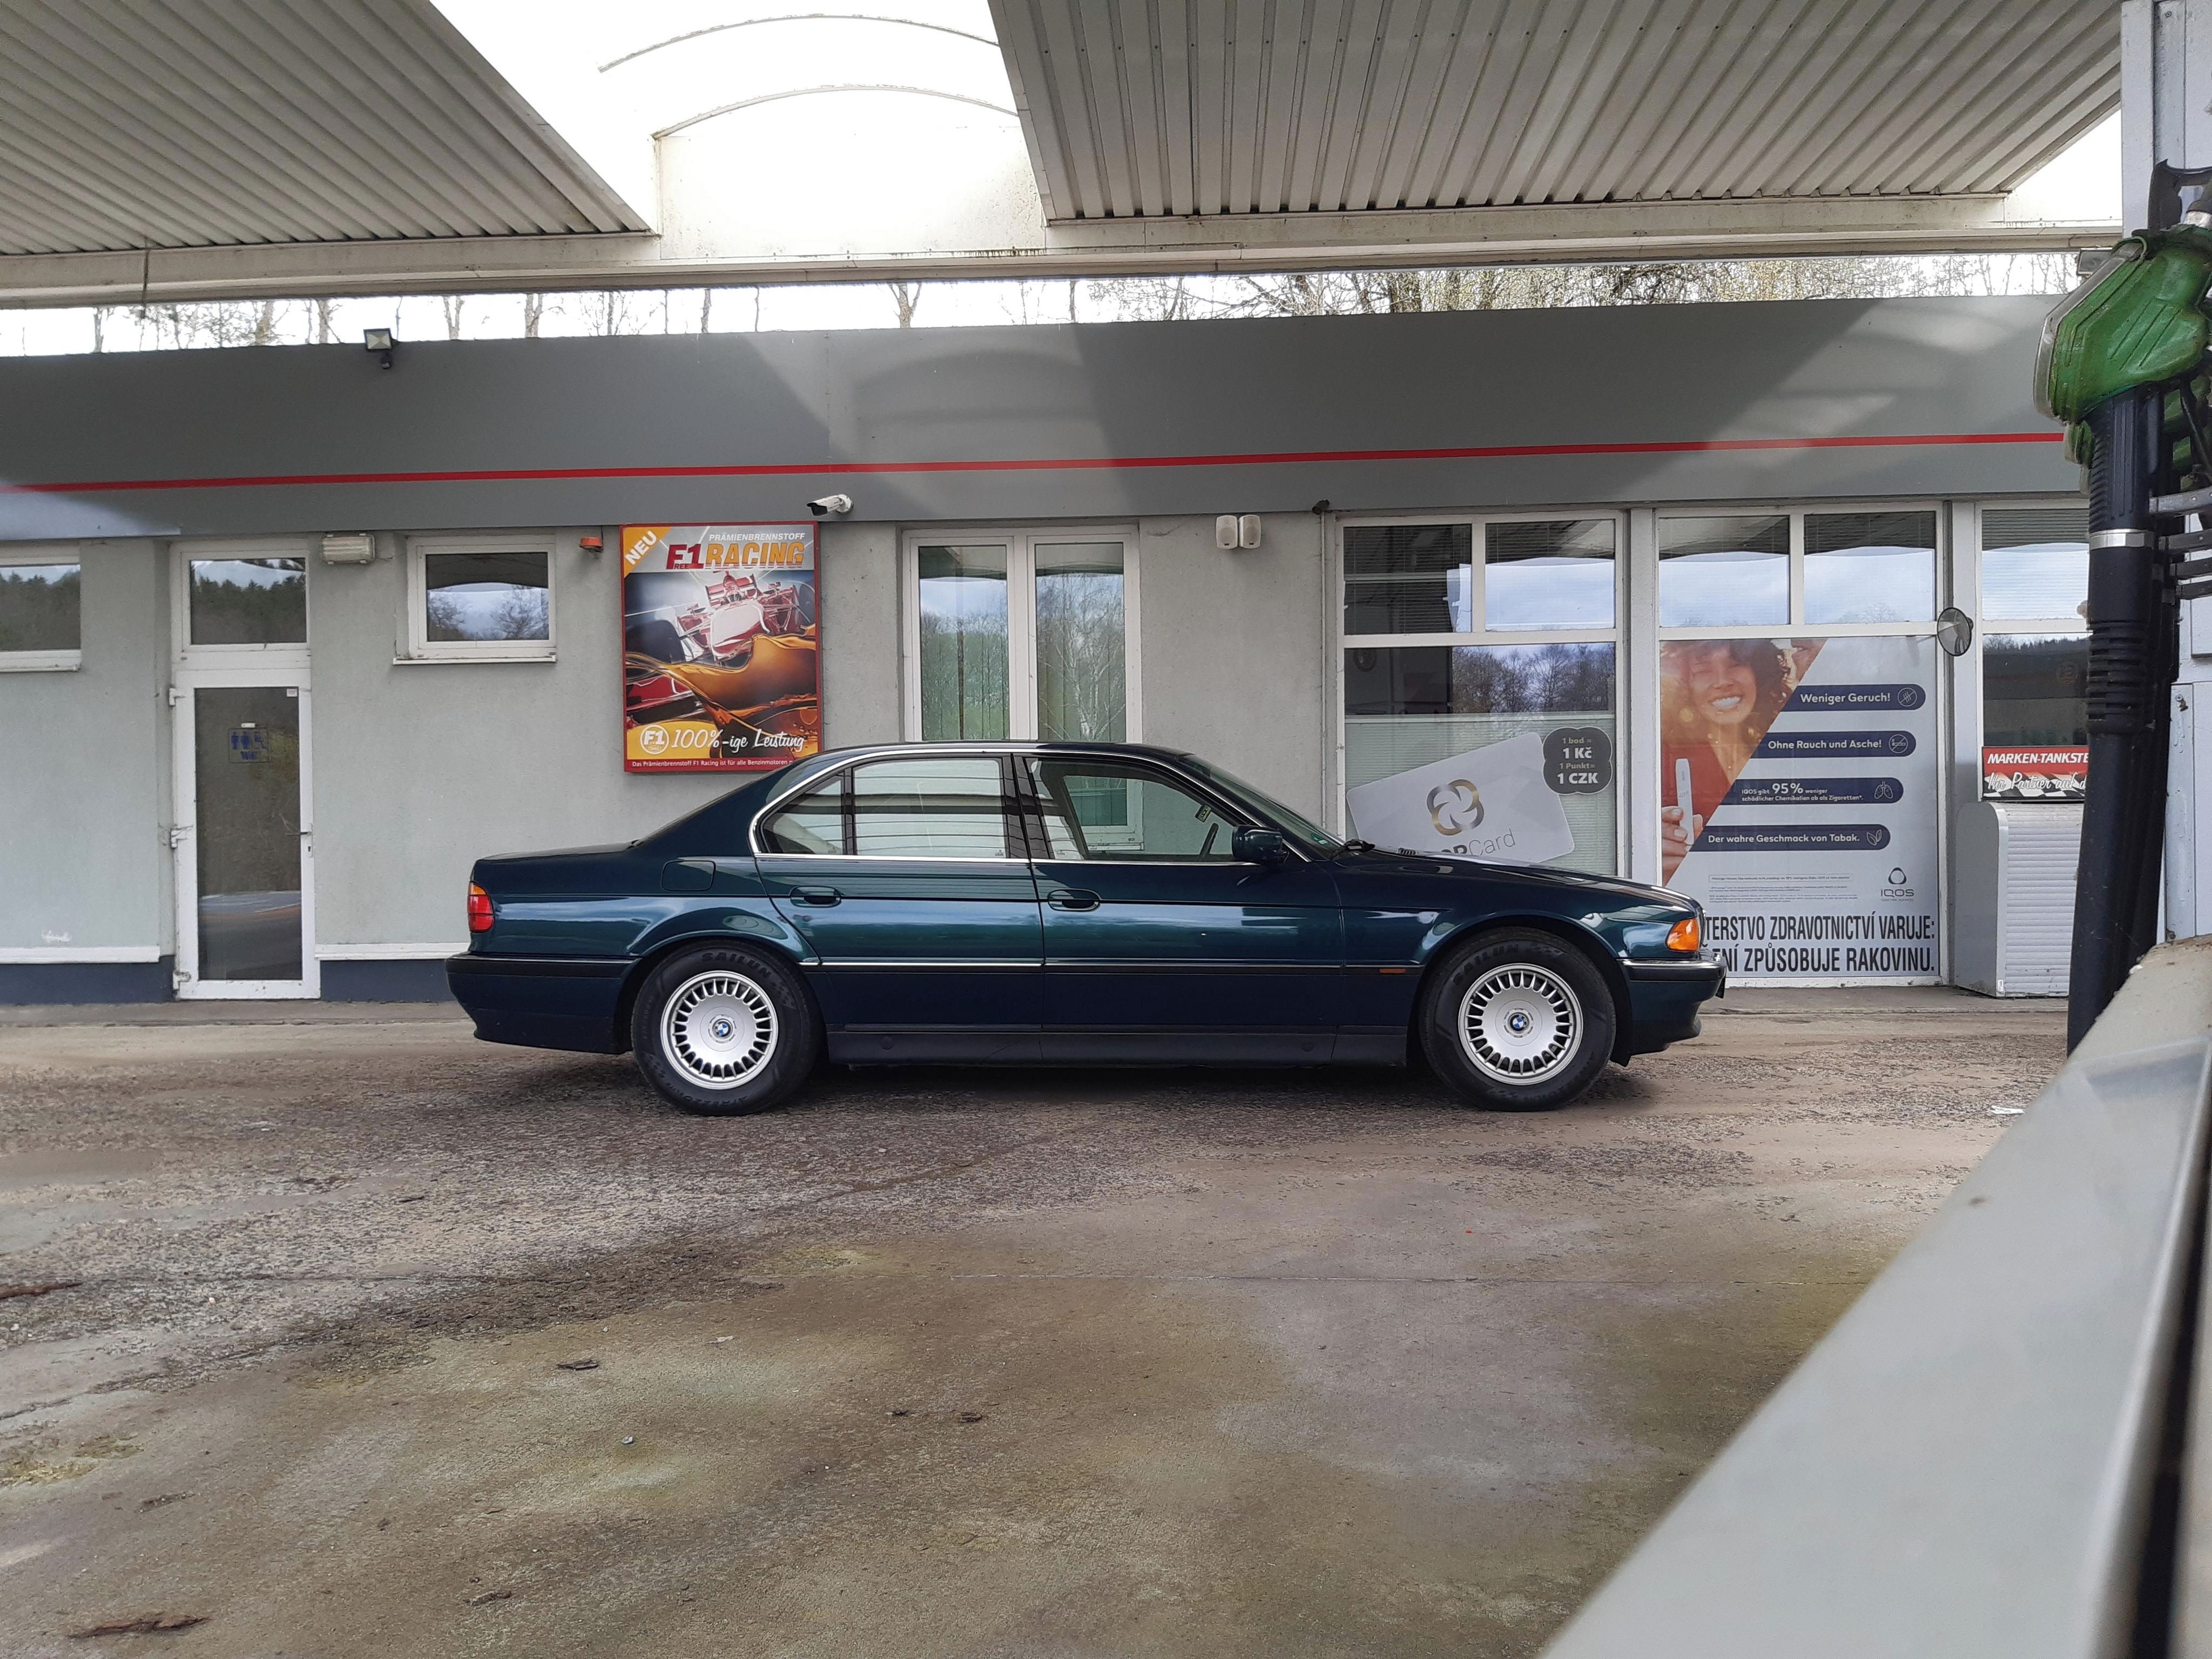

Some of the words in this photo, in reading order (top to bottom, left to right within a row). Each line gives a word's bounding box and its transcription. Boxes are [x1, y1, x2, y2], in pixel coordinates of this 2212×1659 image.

[708, 532, 806, 542] PRÄMIENBRENNSTOFF
[624, 530, 657, 565] NEU
[705, 541, 805, 569] RACING
[1800, 693, 1845, 705] Weniger
[1848, 692, 1891, 702] Geruch!
[644, 730, 665, 745] F1
[754, 729, 805, 752] Leistung
[1768, 740, 1794, 749] Ohne
[1796, 740, 1826, 748] Rauch
[1829, 740, 1846, 748] und
[1849, 739, 1882, 748] Asche!
[1562, 747, 1569, 759] 1
[1574, 747, 1592, 759] Kč
[1557, 773, 1564, 784] 1
[1568, 773, 1599, 784] CZK
[1988, 772, 2006, 790] Ihr
[2011, 772, 2052, 790] Partner
[2055, 773, 2079, 790] auf
[1756, 834, 1809, 842] Geschmack
[1829, 834, 1860, 842] Tabak.
[1880, 889, 1914, 898] IQOS
[1770, 911, 1876, 940] ZDRAVOTNICTVÍ
[1879, 915, 1935, 940] VARUJE:
[1744, 942, 1840, 972] ZPŮSOBUJE
[1846, 947, 1935, 972] RAKOVINU.
